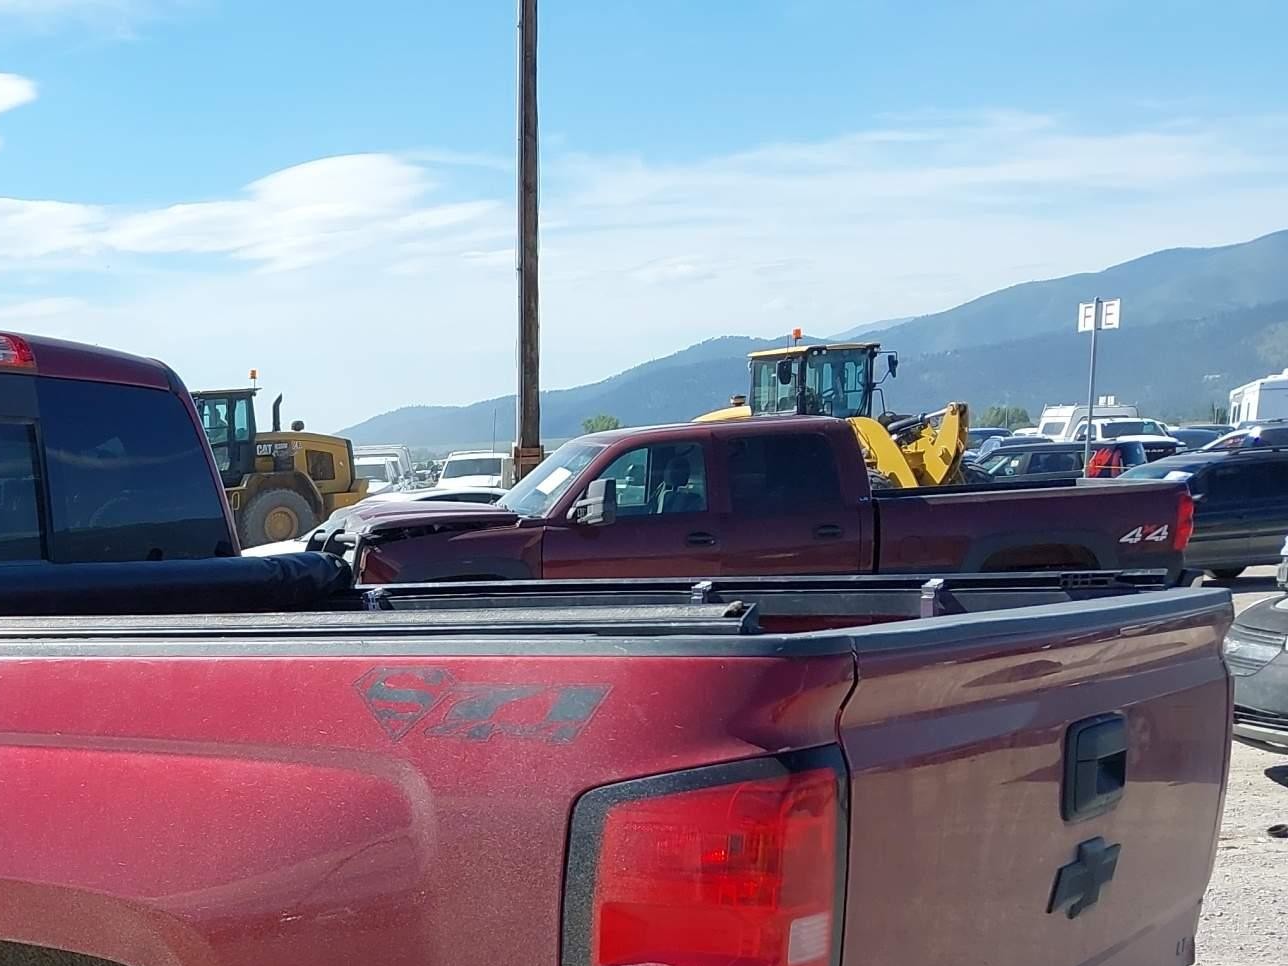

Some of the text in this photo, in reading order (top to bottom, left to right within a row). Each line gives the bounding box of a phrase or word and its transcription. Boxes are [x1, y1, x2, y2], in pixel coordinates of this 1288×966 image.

[1083, 305, 1094, 329] F
[1104, 302, 1115, 326] E
[256, 443, 273, 456] CAT
